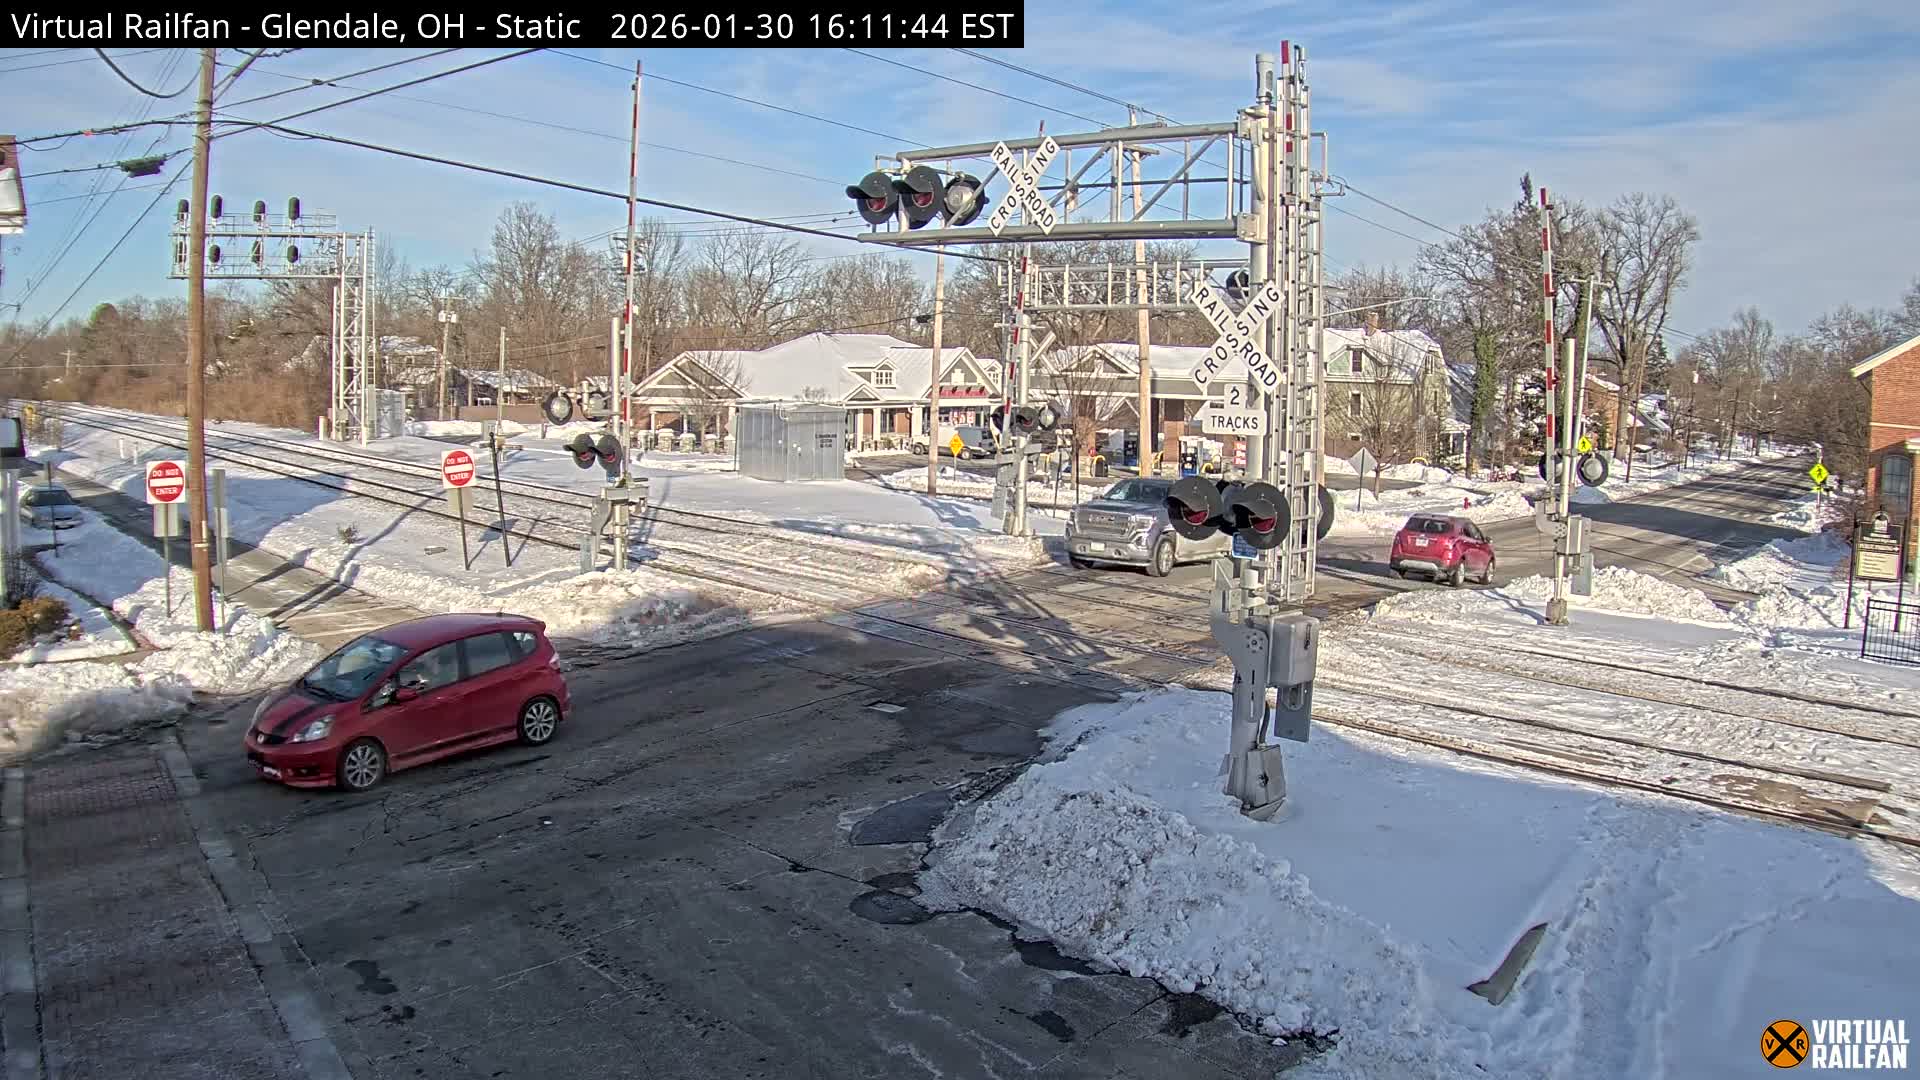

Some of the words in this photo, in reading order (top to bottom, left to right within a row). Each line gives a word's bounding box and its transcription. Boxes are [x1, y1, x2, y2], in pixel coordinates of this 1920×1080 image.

[1230, 387, 1240, 406] 2
[1211, 415, 1258, 430] TRACKS
[165, 468, 179, 476] NOT
[155, 487, 177, 495] ENTER
